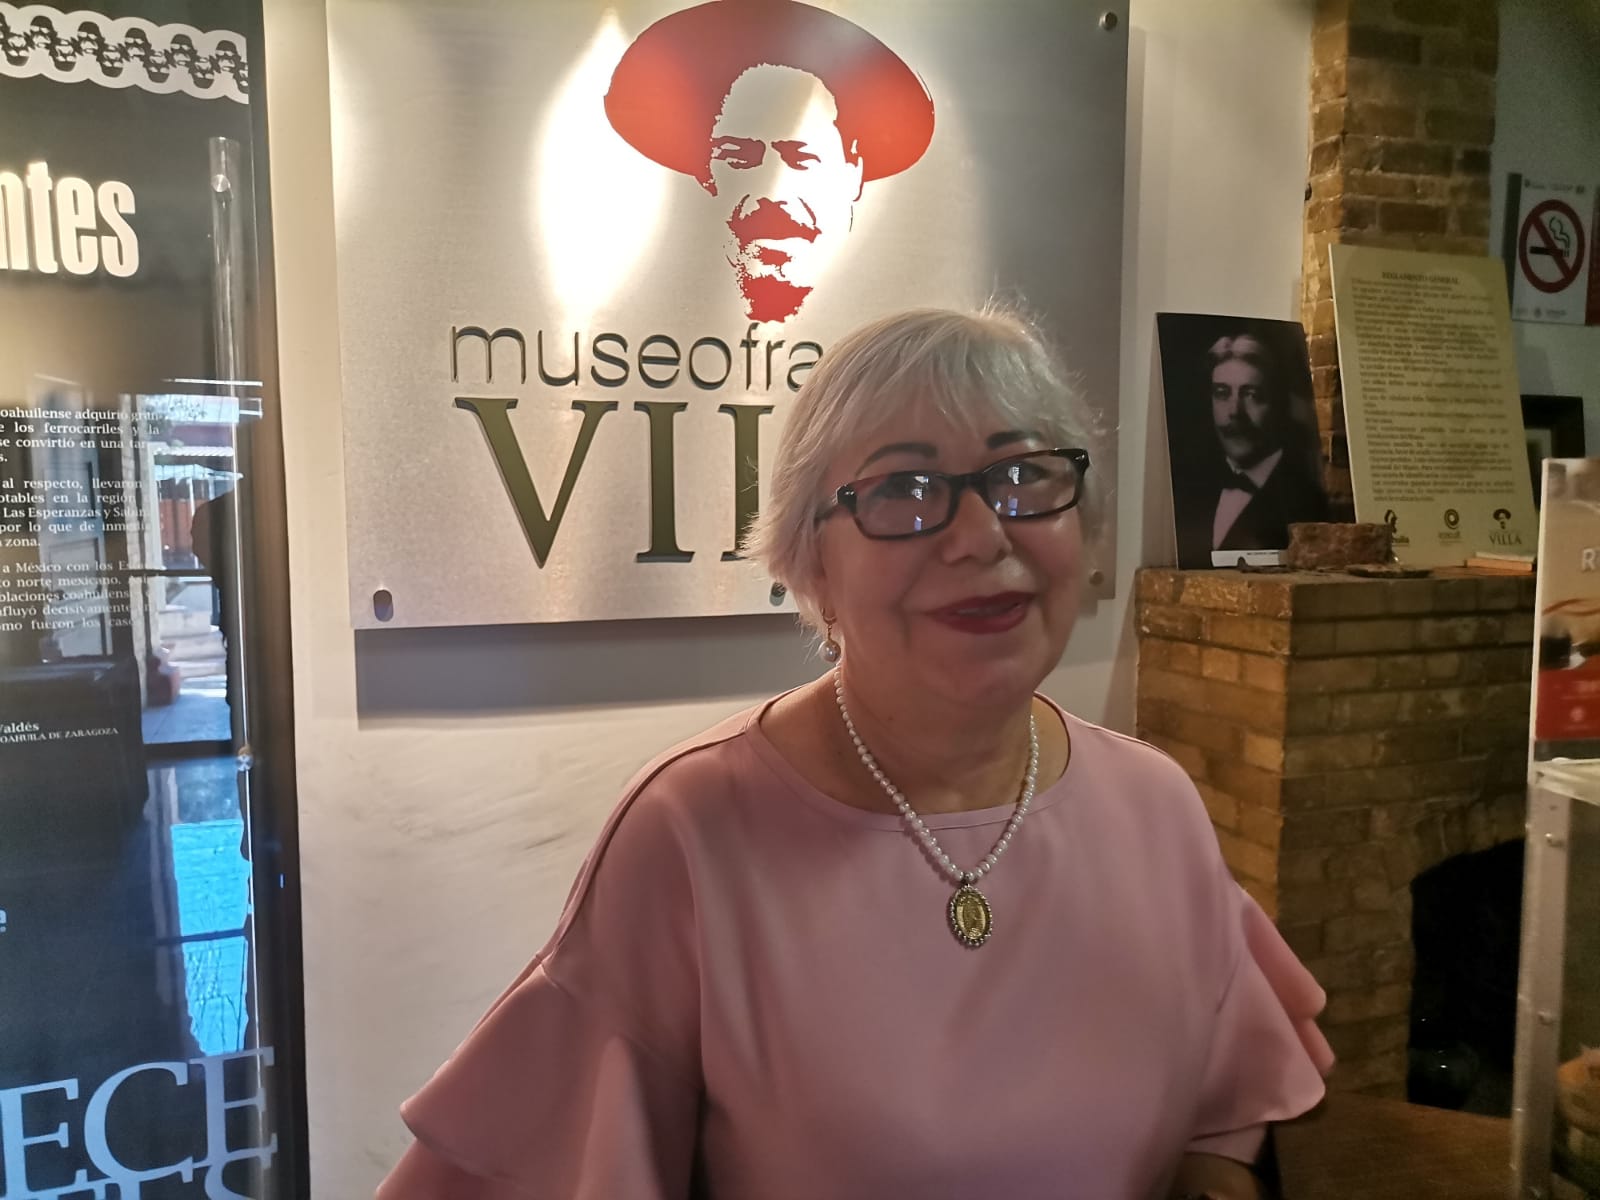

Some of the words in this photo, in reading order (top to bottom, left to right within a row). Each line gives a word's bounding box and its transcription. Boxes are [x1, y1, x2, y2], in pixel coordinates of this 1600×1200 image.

[14, 421, 34, 433] los
[44, 422, 123, 434] ferrocarriles
[148, 424, 160, 435] la
[16, 438, 75, 448] convirtió
[80, 439, 96, 449] en
[100, 440, 124, 449] una
[2, 477, 14, 489] al
[24, 479, 83, 491] respecto,
[92, 477, 142, 489] llevaron
[53, 494, 69, 503] en
[77, 492, 88, 503] la
[3, 507, 26, 518] Las
[28, 507, 102, 519] Esperanzas
[103, 508, 111, 519] y
[0, 524, 21, 534] por
[28, 521, 41, 532] lo
[48, 523, 72, 534] que
[80, 520, 95, 532] de
[5, 538, 41, 547] zona.
[3, 564, 10, 573] a
[16, 562, 61, 573] México
[66, 563, 90, 572] con
[95, 561, 113, 571] los
[17, 578, 52, 588] norte
[58, 575, 121, 587] mexicano.
[62, 589, 138, 601] coahuilens
[42, 603, 132, 616] decisivamente
[0, 621, 23, 631] mo
[31, 620, 74, 630] fueron
[82, 616, 101, 628] los
[48, 731, 62, 740] DE
[64, 727, 119, 739] ZARAGOZA
